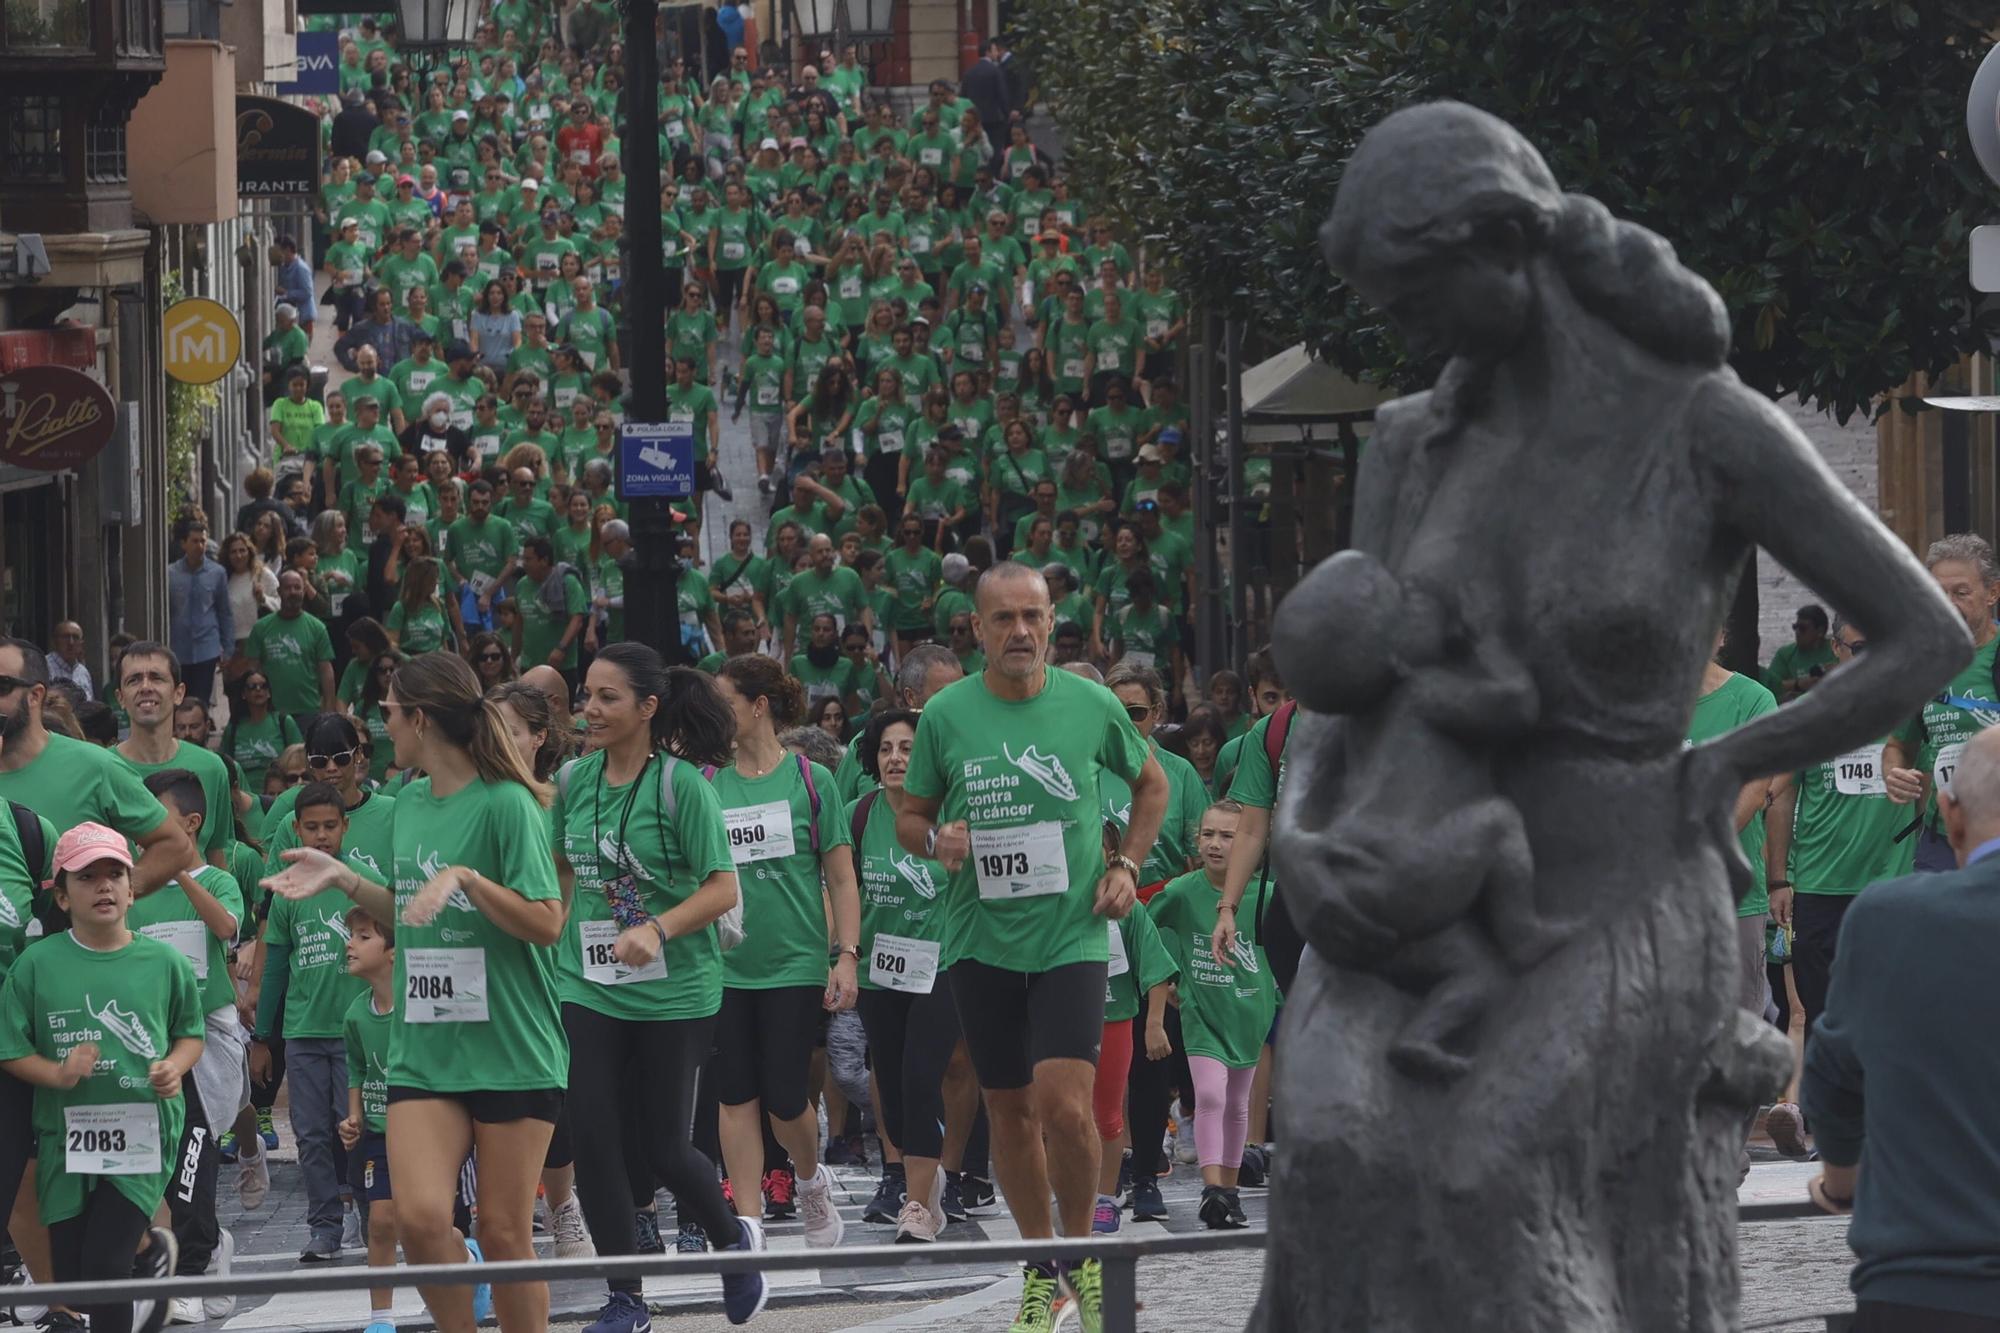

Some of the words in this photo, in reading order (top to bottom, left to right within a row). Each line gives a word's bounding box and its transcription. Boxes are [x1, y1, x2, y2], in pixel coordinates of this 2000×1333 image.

[5, 393, 101, 453] Rialto
[964, 763, 981, 777] En
[1840, 763, 1873, 779] 1748
[1939, 765, 1955, 783] 17
[966, 774, 1020, 792] marcha
[967, 791, 1012, 807] contra
[969, 807, 980, 821] el
[983, 803, 1034, 819] cáncer
[567, 853, 600, 864] archa
[979, 852, 1029, 877] 1973
[575, 865, 599, 876] ntra
[296, 926, 307, 936] En
[1193, 935, 1204, 946] En
[299, 955, 307, 966] el
[309, 952, 338, 965] cáncer
[586, 944, 619, 965] 183
[1193, 947, 1214, 959] marc
[876, 952, 906, 974] 620
[1191, 959, 1221, 971] contra
[1200, 971, 1234, 983] cáncer
[409, 975, 454, 999] 2084
[48, 1015, 66, 1029] En
[52, 1028, 102, 1043] marcha
[362, 1091, 387, 1102] ontra
[69, 1129, 126, 1152] 2083
[178, 1126, 207, 1203] LEGEA
